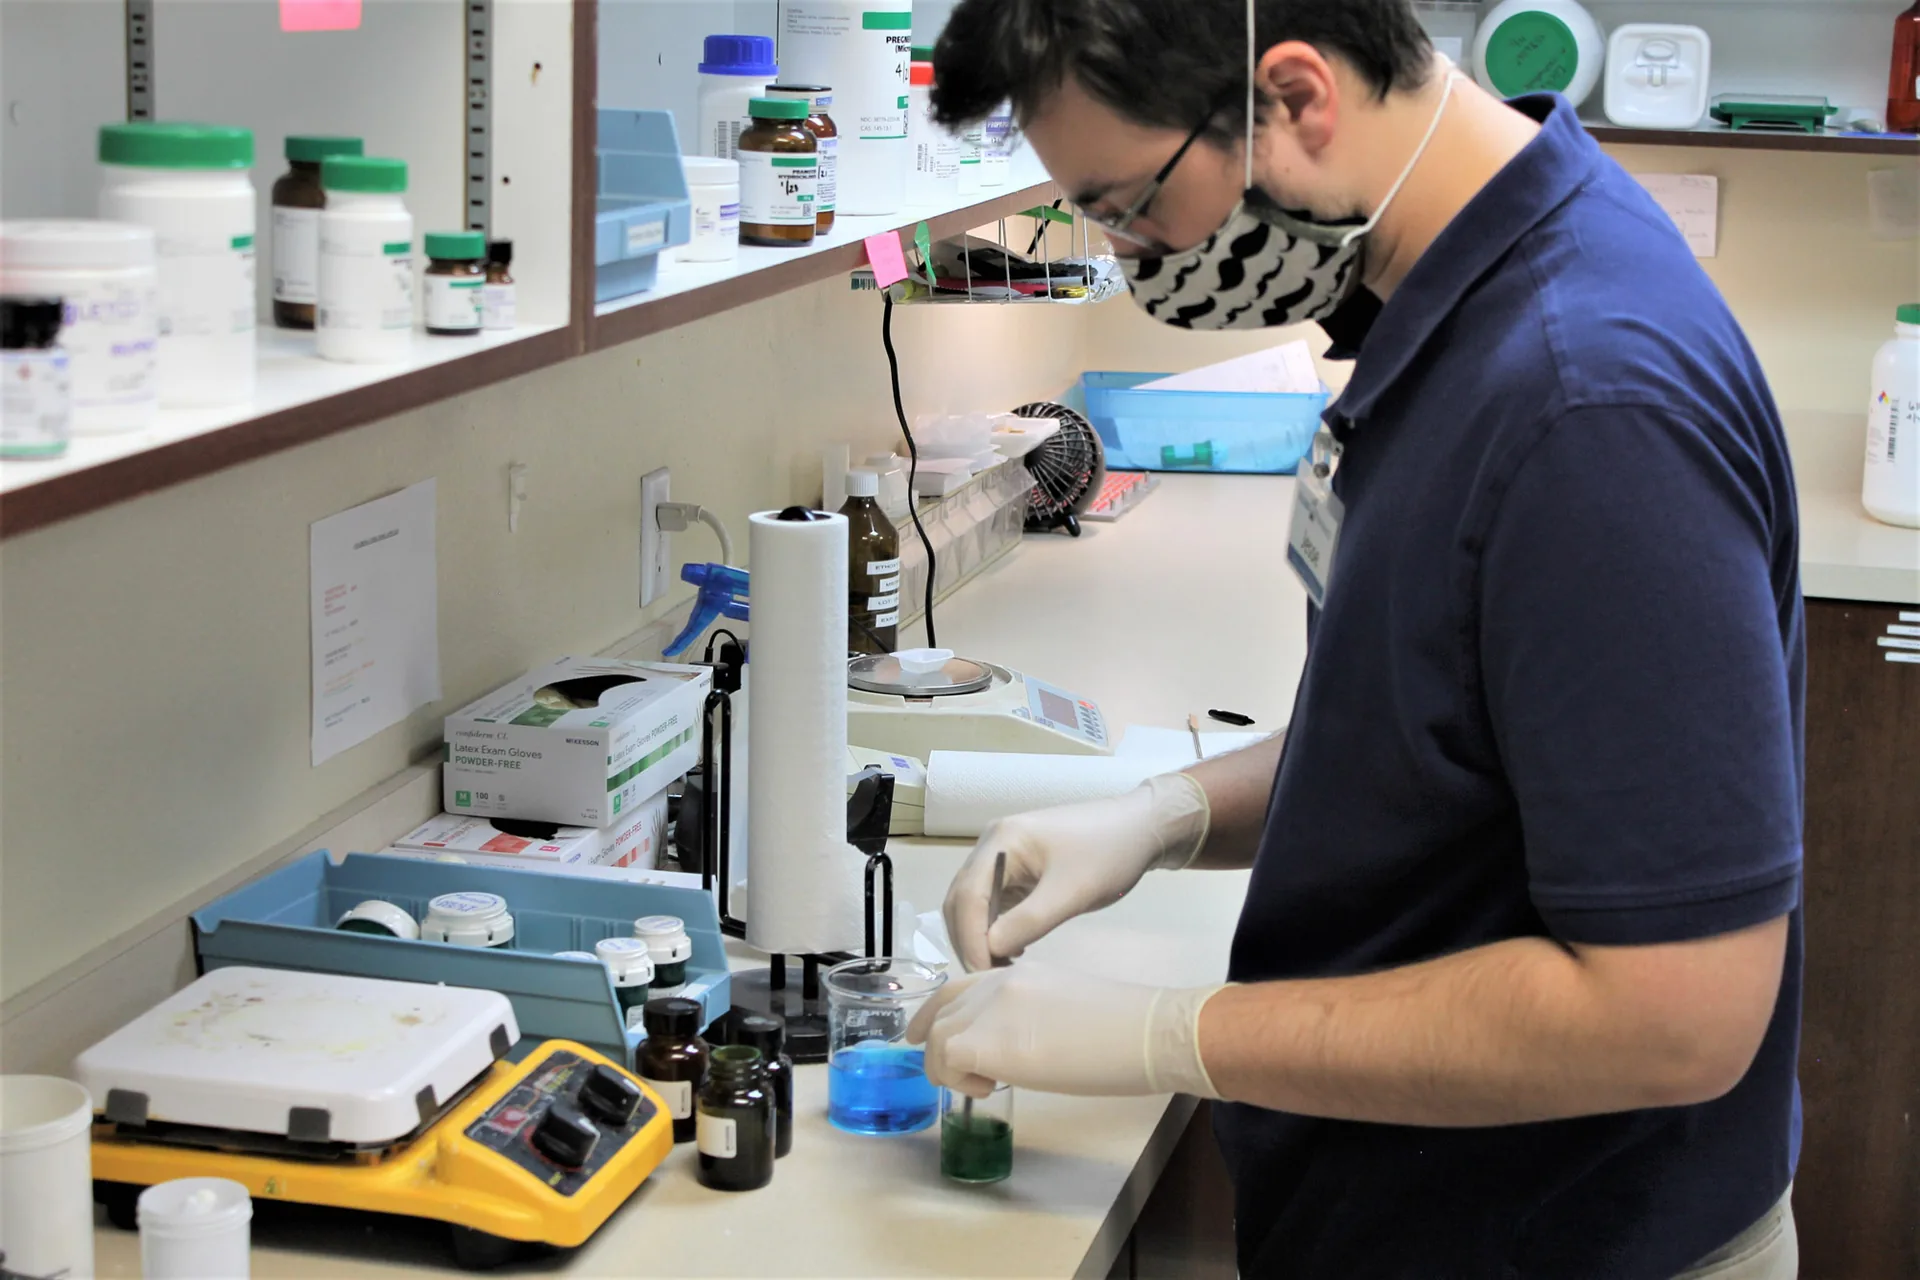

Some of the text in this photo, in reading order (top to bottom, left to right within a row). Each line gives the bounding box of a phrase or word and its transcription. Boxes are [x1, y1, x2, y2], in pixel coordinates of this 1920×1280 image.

[454, 742, 543, 759] Latex Exam Gloves
[455, 755, 522, 770] POWDER-FREE
[475, 792, 489, 800] 100
